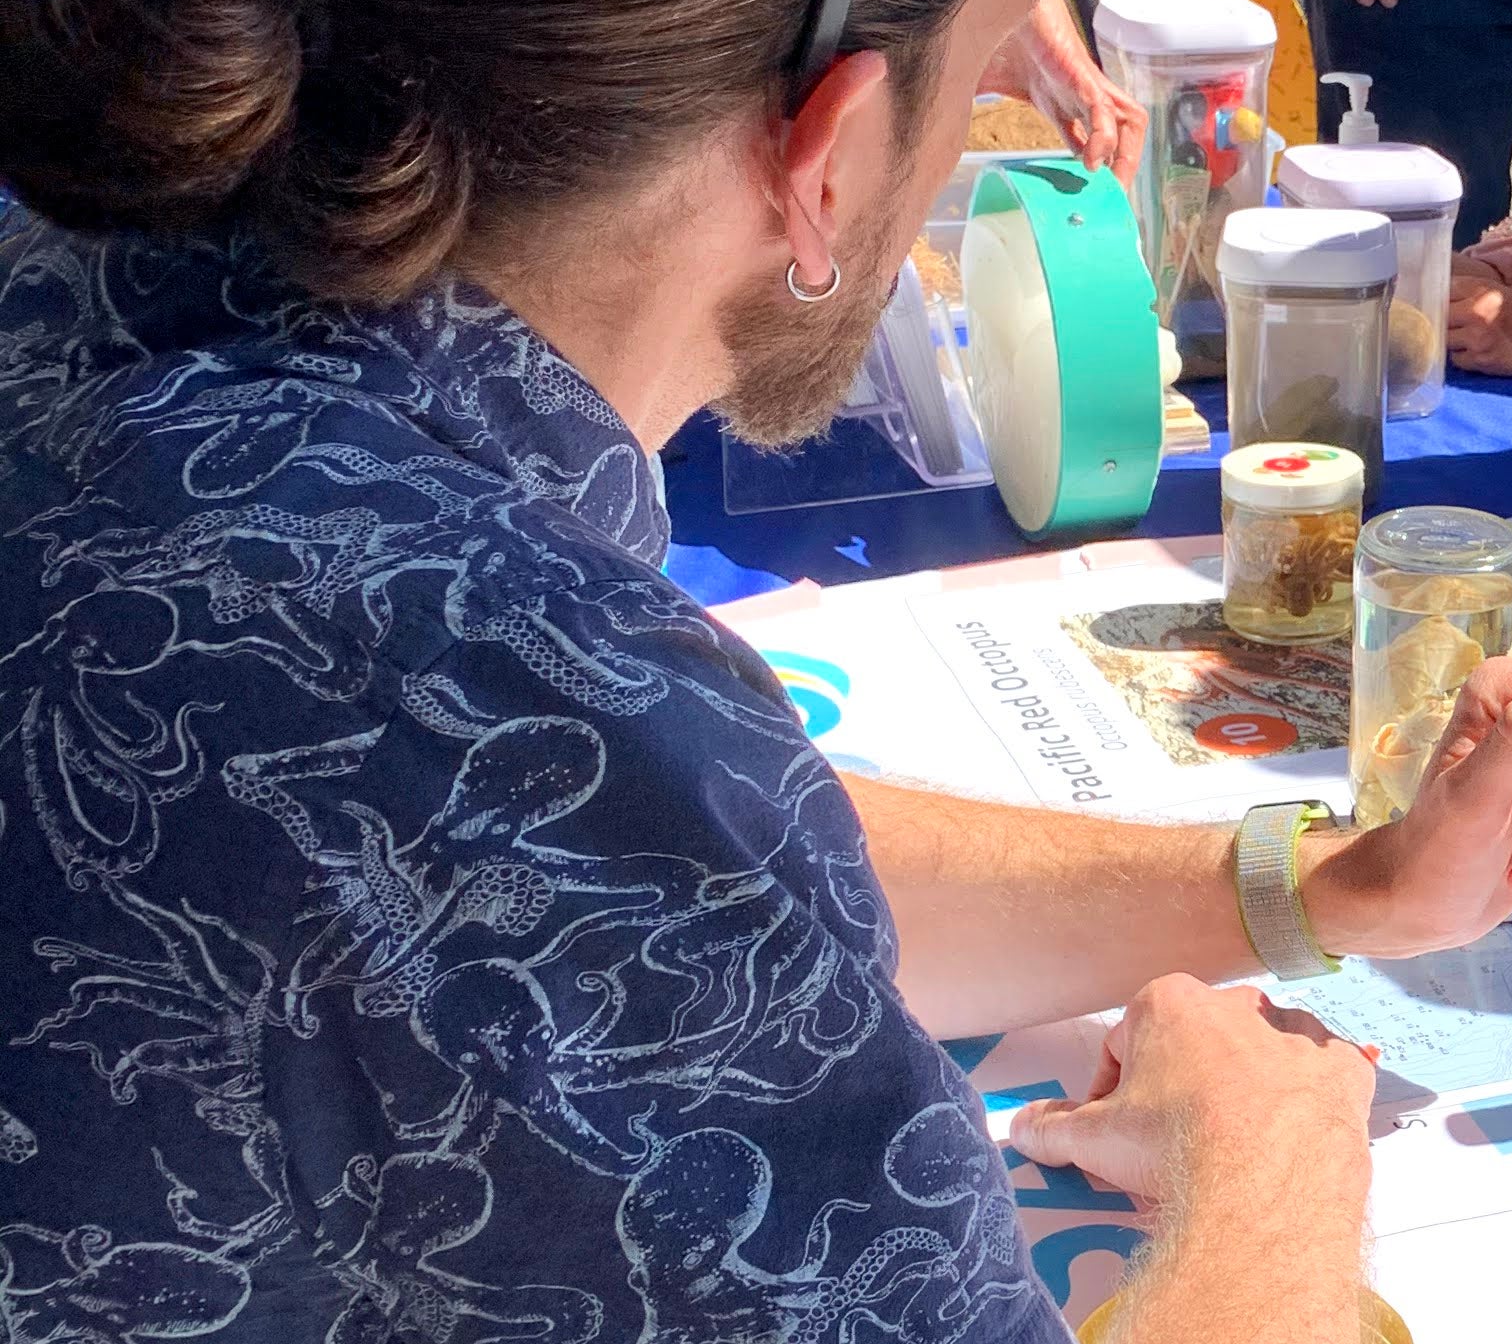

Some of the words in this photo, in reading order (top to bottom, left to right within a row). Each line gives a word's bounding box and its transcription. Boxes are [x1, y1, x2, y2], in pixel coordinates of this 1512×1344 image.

[956, 620, 1029, 691] Octopus
[1001, 694, 1061, 732] Red
[1220, 722, 1268, 747] 10
[1037, 733, 1112, 803] Pacific
